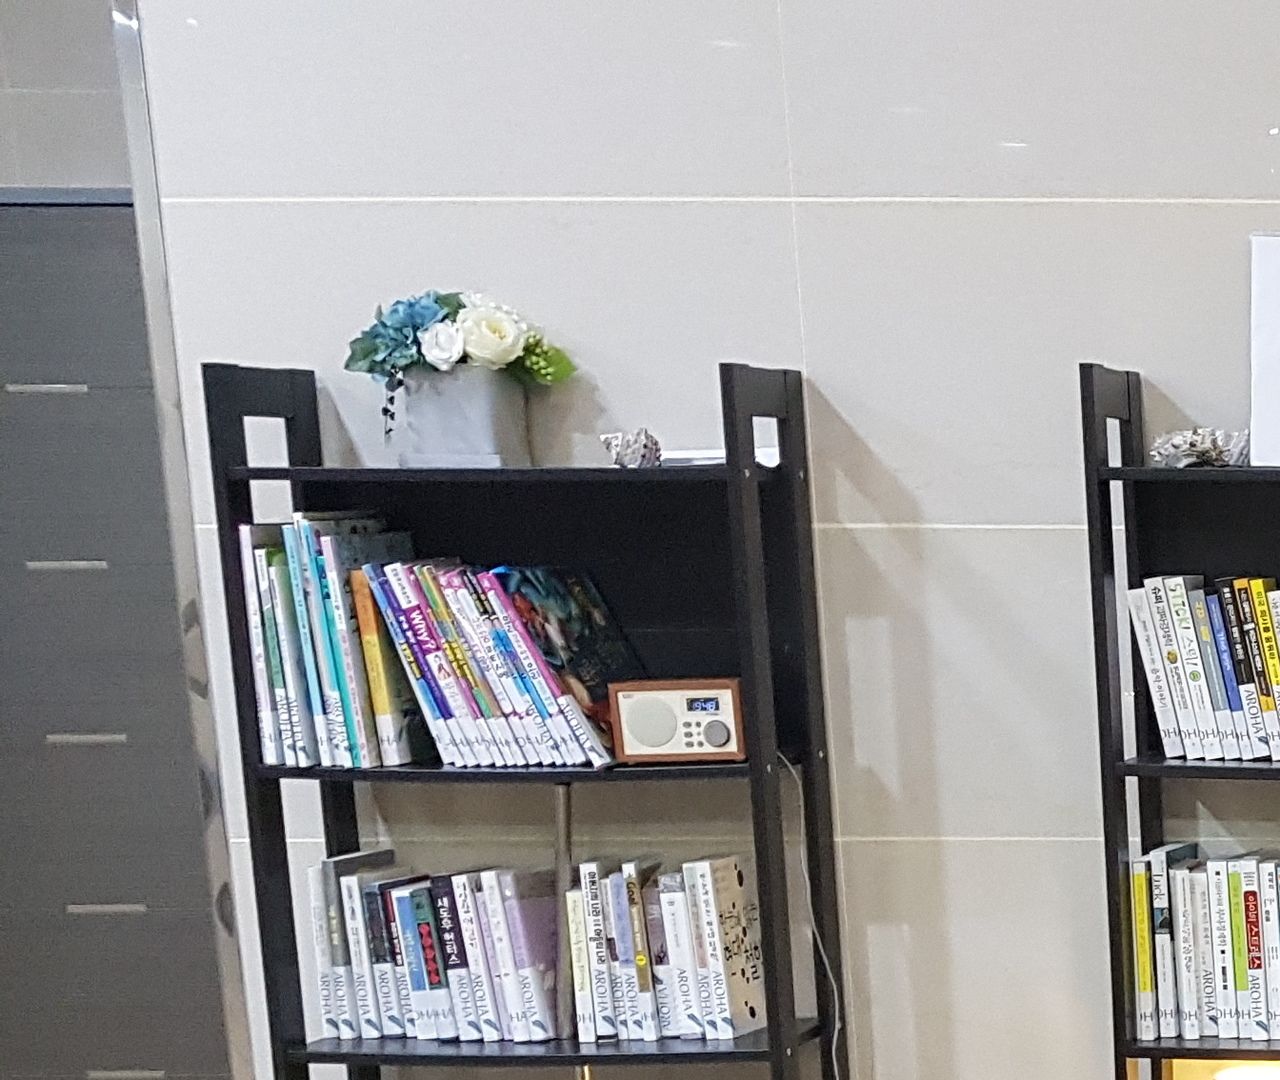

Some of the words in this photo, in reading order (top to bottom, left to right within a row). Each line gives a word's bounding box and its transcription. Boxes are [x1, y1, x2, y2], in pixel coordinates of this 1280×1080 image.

[1151, 585, 1163, 605] 슈퍼
[1244, 690, 1263, 734] AROHA
[1153, 873, 1166, 901] Luck
[1247, 895, 1258, 922] 아이의
[1247, 923, 1262, 970] 스트레스
[377, 969, 395, 1014] AROHA
[457, 974, 474, 1018] AROHA
[471, 973, 490, 1017] AROHA
[519, 974, 538, 1018] AROHA
[594, 969, 609, 1013] AROHA
[677, 967, 693, 1011] AROHA
[712, 970, 728, 1019] AROHA
[1202, 969, 1215, 1016] AROHA
[1249, 975, 1263, 1018] AROHA
